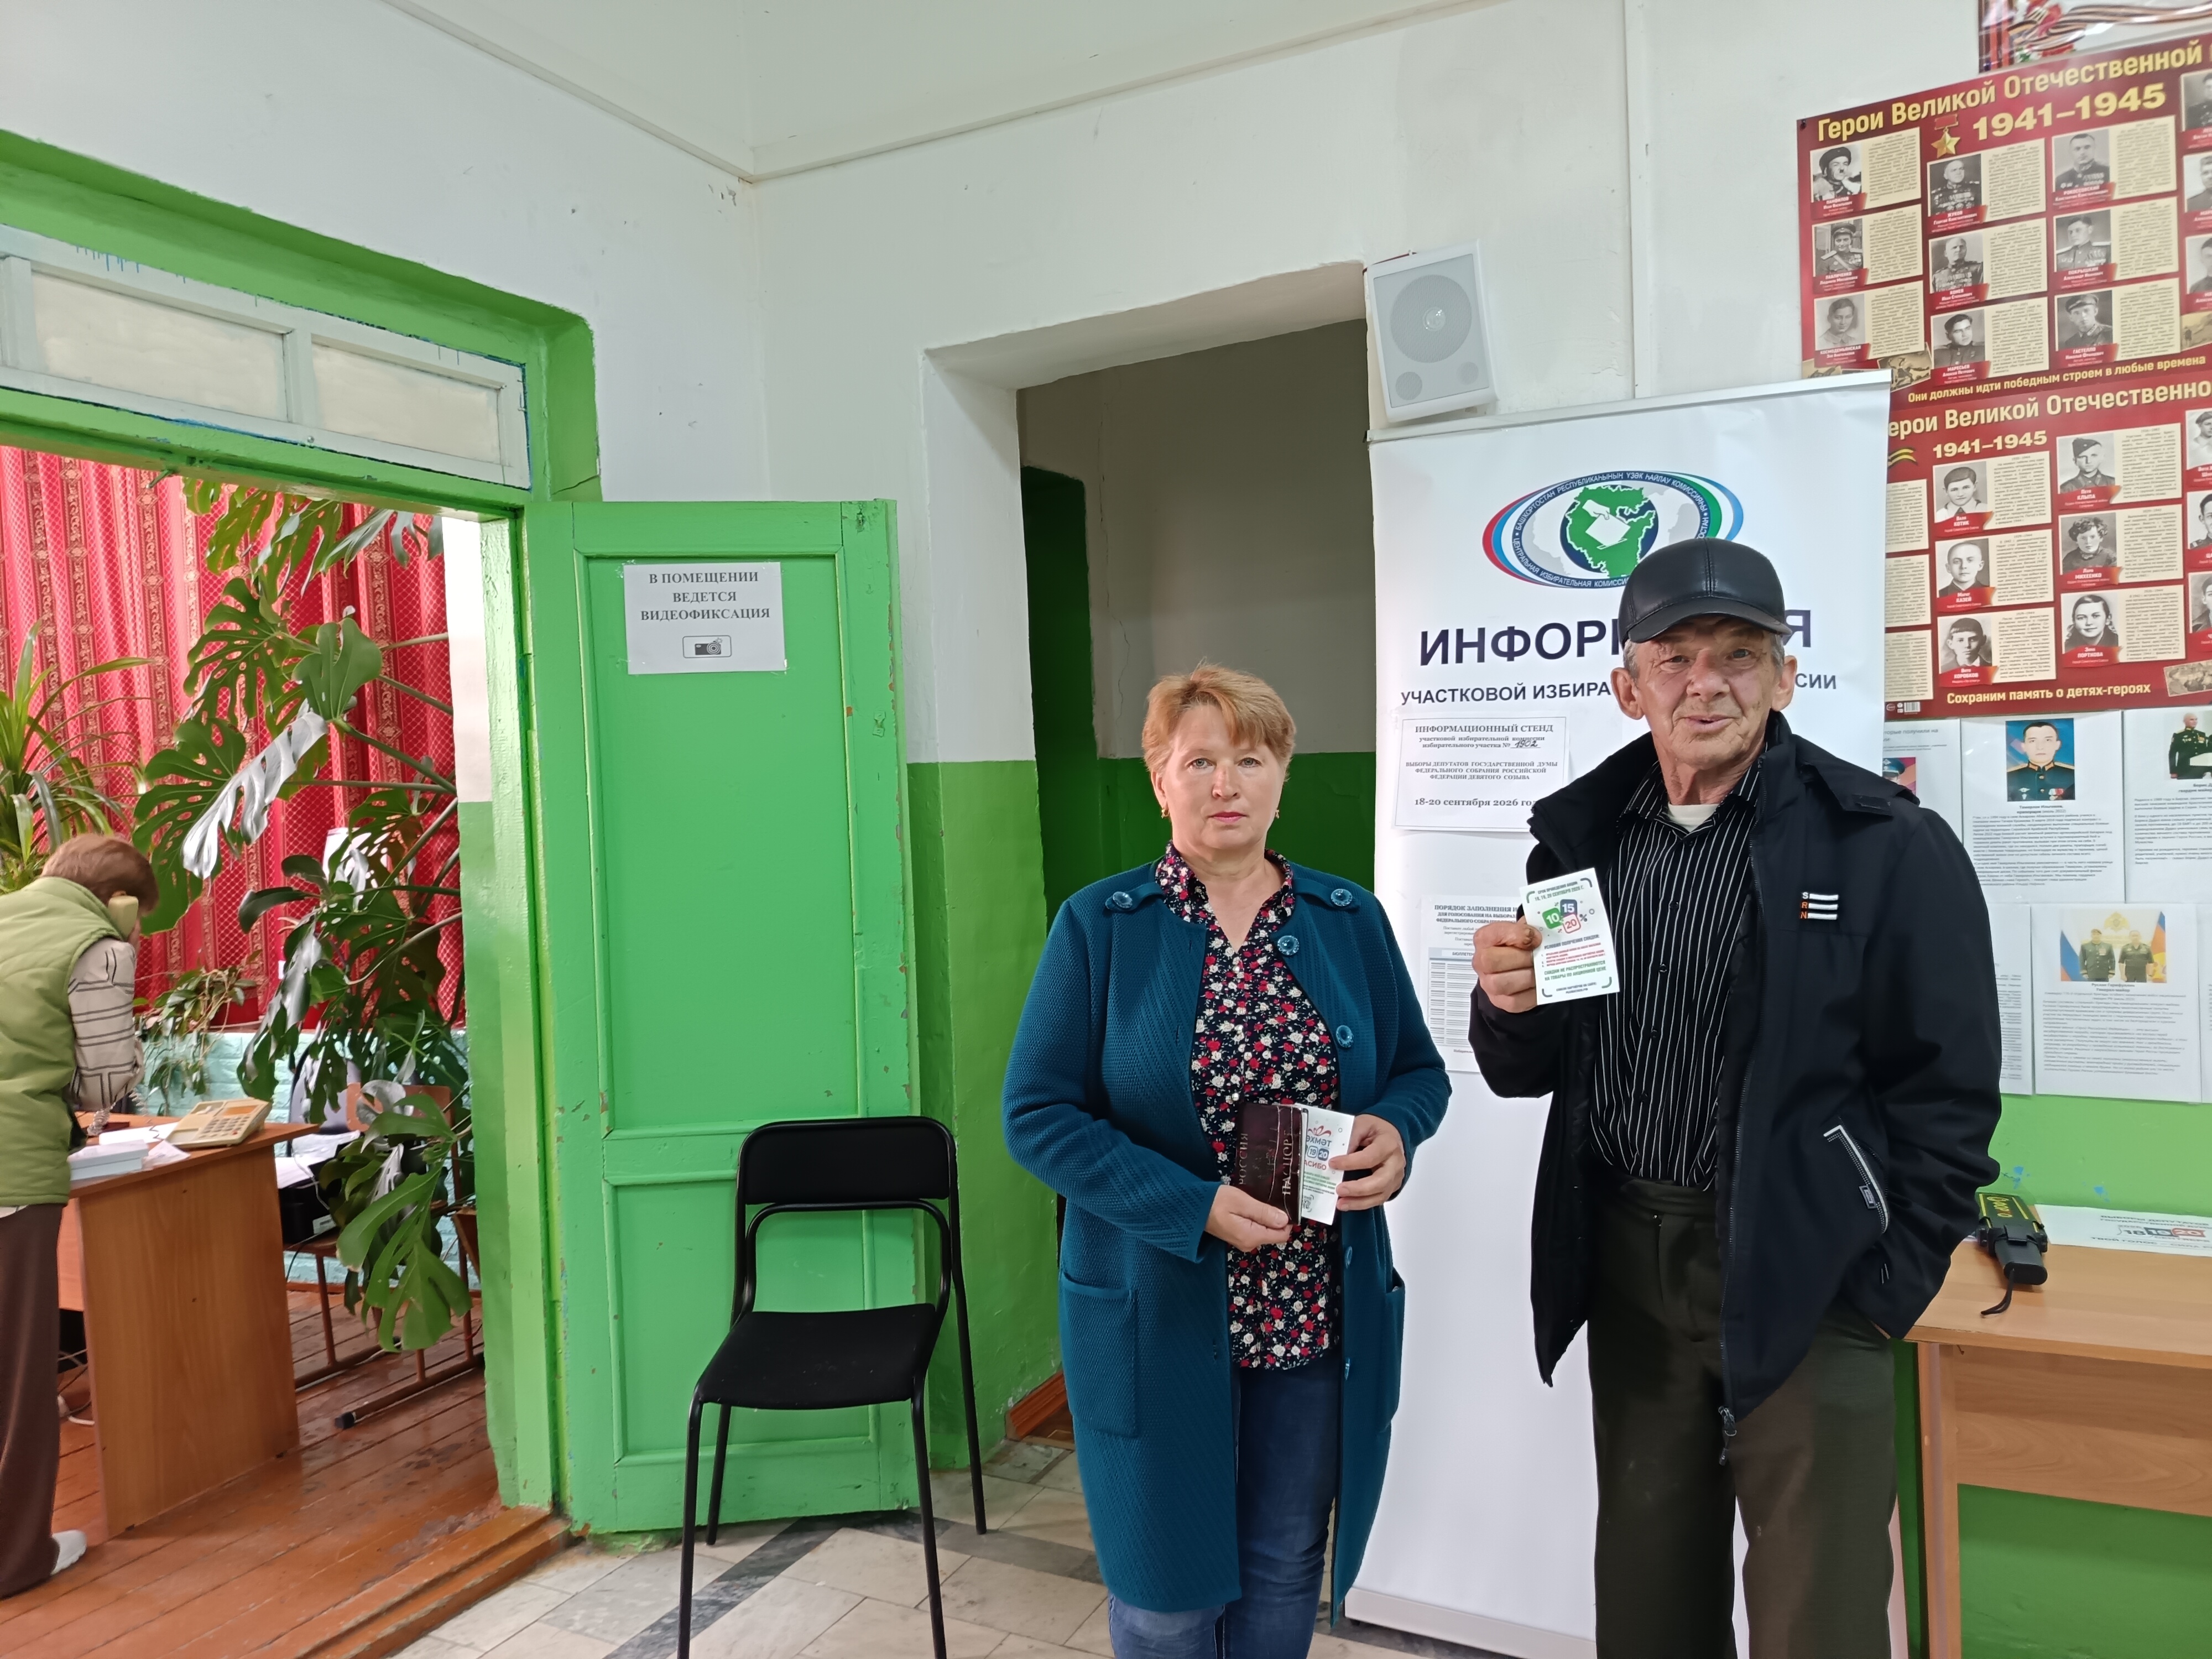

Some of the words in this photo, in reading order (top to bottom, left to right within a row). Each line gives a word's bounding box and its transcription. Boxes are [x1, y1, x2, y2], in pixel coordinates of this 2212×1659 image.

[1818, 111, 1884, 141] Герои
[1892, 80, 1995, 126] Великой
[2004, 39, 2203, 98] Отечественной
[1908, 392, 1927, 403] Они
[1929, 387, 1973, 401] должны
[1976, 383, 2001, 394] идти
[2004, 373, 2060, 389] победным
[2063, 368, 2103, 383] строем
[2106, 368, 2111, 376] в
[2114, 362, 2154, 375] любые
[2157, 356, 2206, 370] времена
[1888, 416, 1937, 440] ерои
[1945, 397, 2039, 429] Великой
[2047, 380, 2212, 415] Отечественно
[1512, 538, 1540, 573] ЦЕНТРАЛЬНАЯ
[1540, 570, 1592, 587] ИЗБИРАТЕЛЬНАЯ
[1697, 517, 1709, 539] ОСТАН
[649, 573, 658, 583] В
[661, 572, 758, 584] ПОМЕЩЕНИИ
[672, 591, 737, 603] ВЕДЕТСЯ
[640, 608, 770, 622] ВИДЕОФИКСАЦИЯ
[1401, 683, 1526, 705] УЧАСТКОВОЙ
[1532, 682, 1611, 700] ИЗБИРА
[1794, 673, 1837, 690] СИИ
[1947, 691, 2006, 705] Сохраним
[2009, 688, 2053, 701] память
[2056, 688, 2063, 698] о
[2066, 683, 2151, 698] детях-героях
[1415, 724, 1519, 733] ИНФОРМАЦИОННЫЙ
[1520, 724, 1553, 733] СТЕНД
[1514, 739, 1538, 748] 1902
[1415, 798, 1441, 806] 18-20
[1443, 798, 1490, 808] сентября
[1562, 903, 1575, 913] 15
[1546, 912, 1559, 925] 10
[1565, 919, 1577, 929] 20
[1306, 1135, 1332, 1147] ӘХМӘТ
[1304, 1160, 1327, 1170] АСИБО
